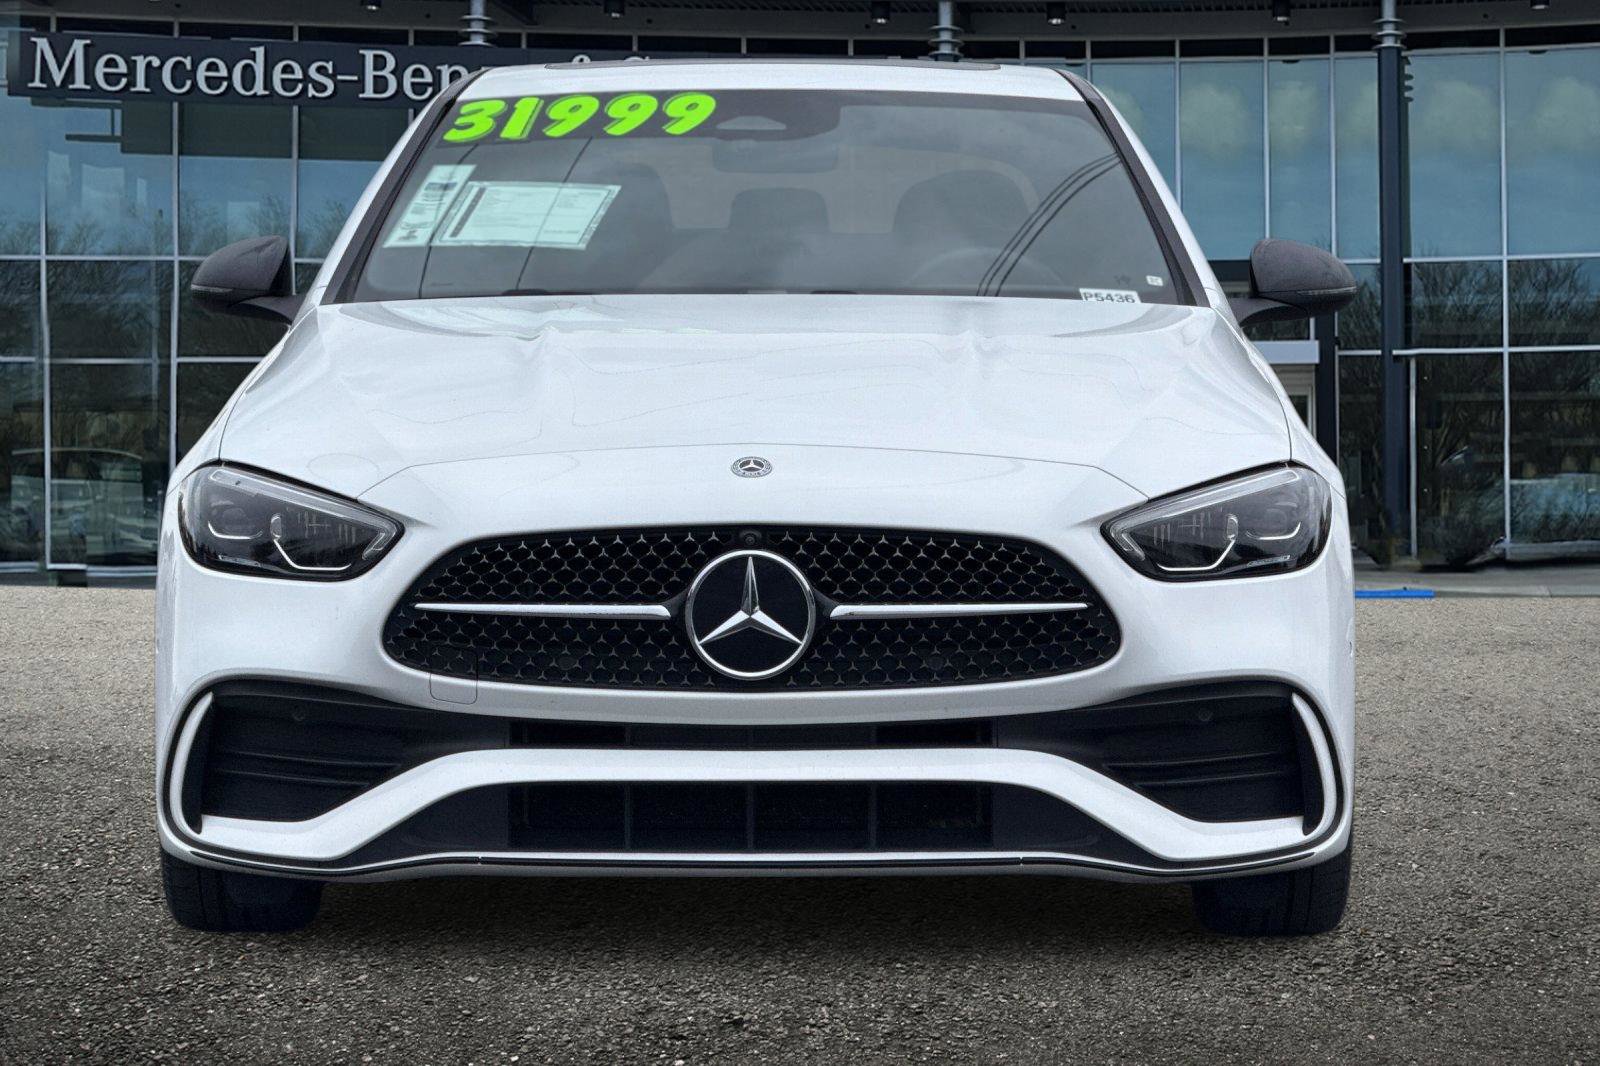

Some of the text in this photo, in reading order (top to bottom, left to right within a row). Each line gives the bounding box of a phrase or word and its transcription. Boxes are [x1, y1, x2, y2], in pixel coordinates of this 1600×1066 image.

[27, 36, 492, 101] Mercedes-Ben
[443, 92, 716, 141] 31999
[1082, 291, 1136, 303] P5436
